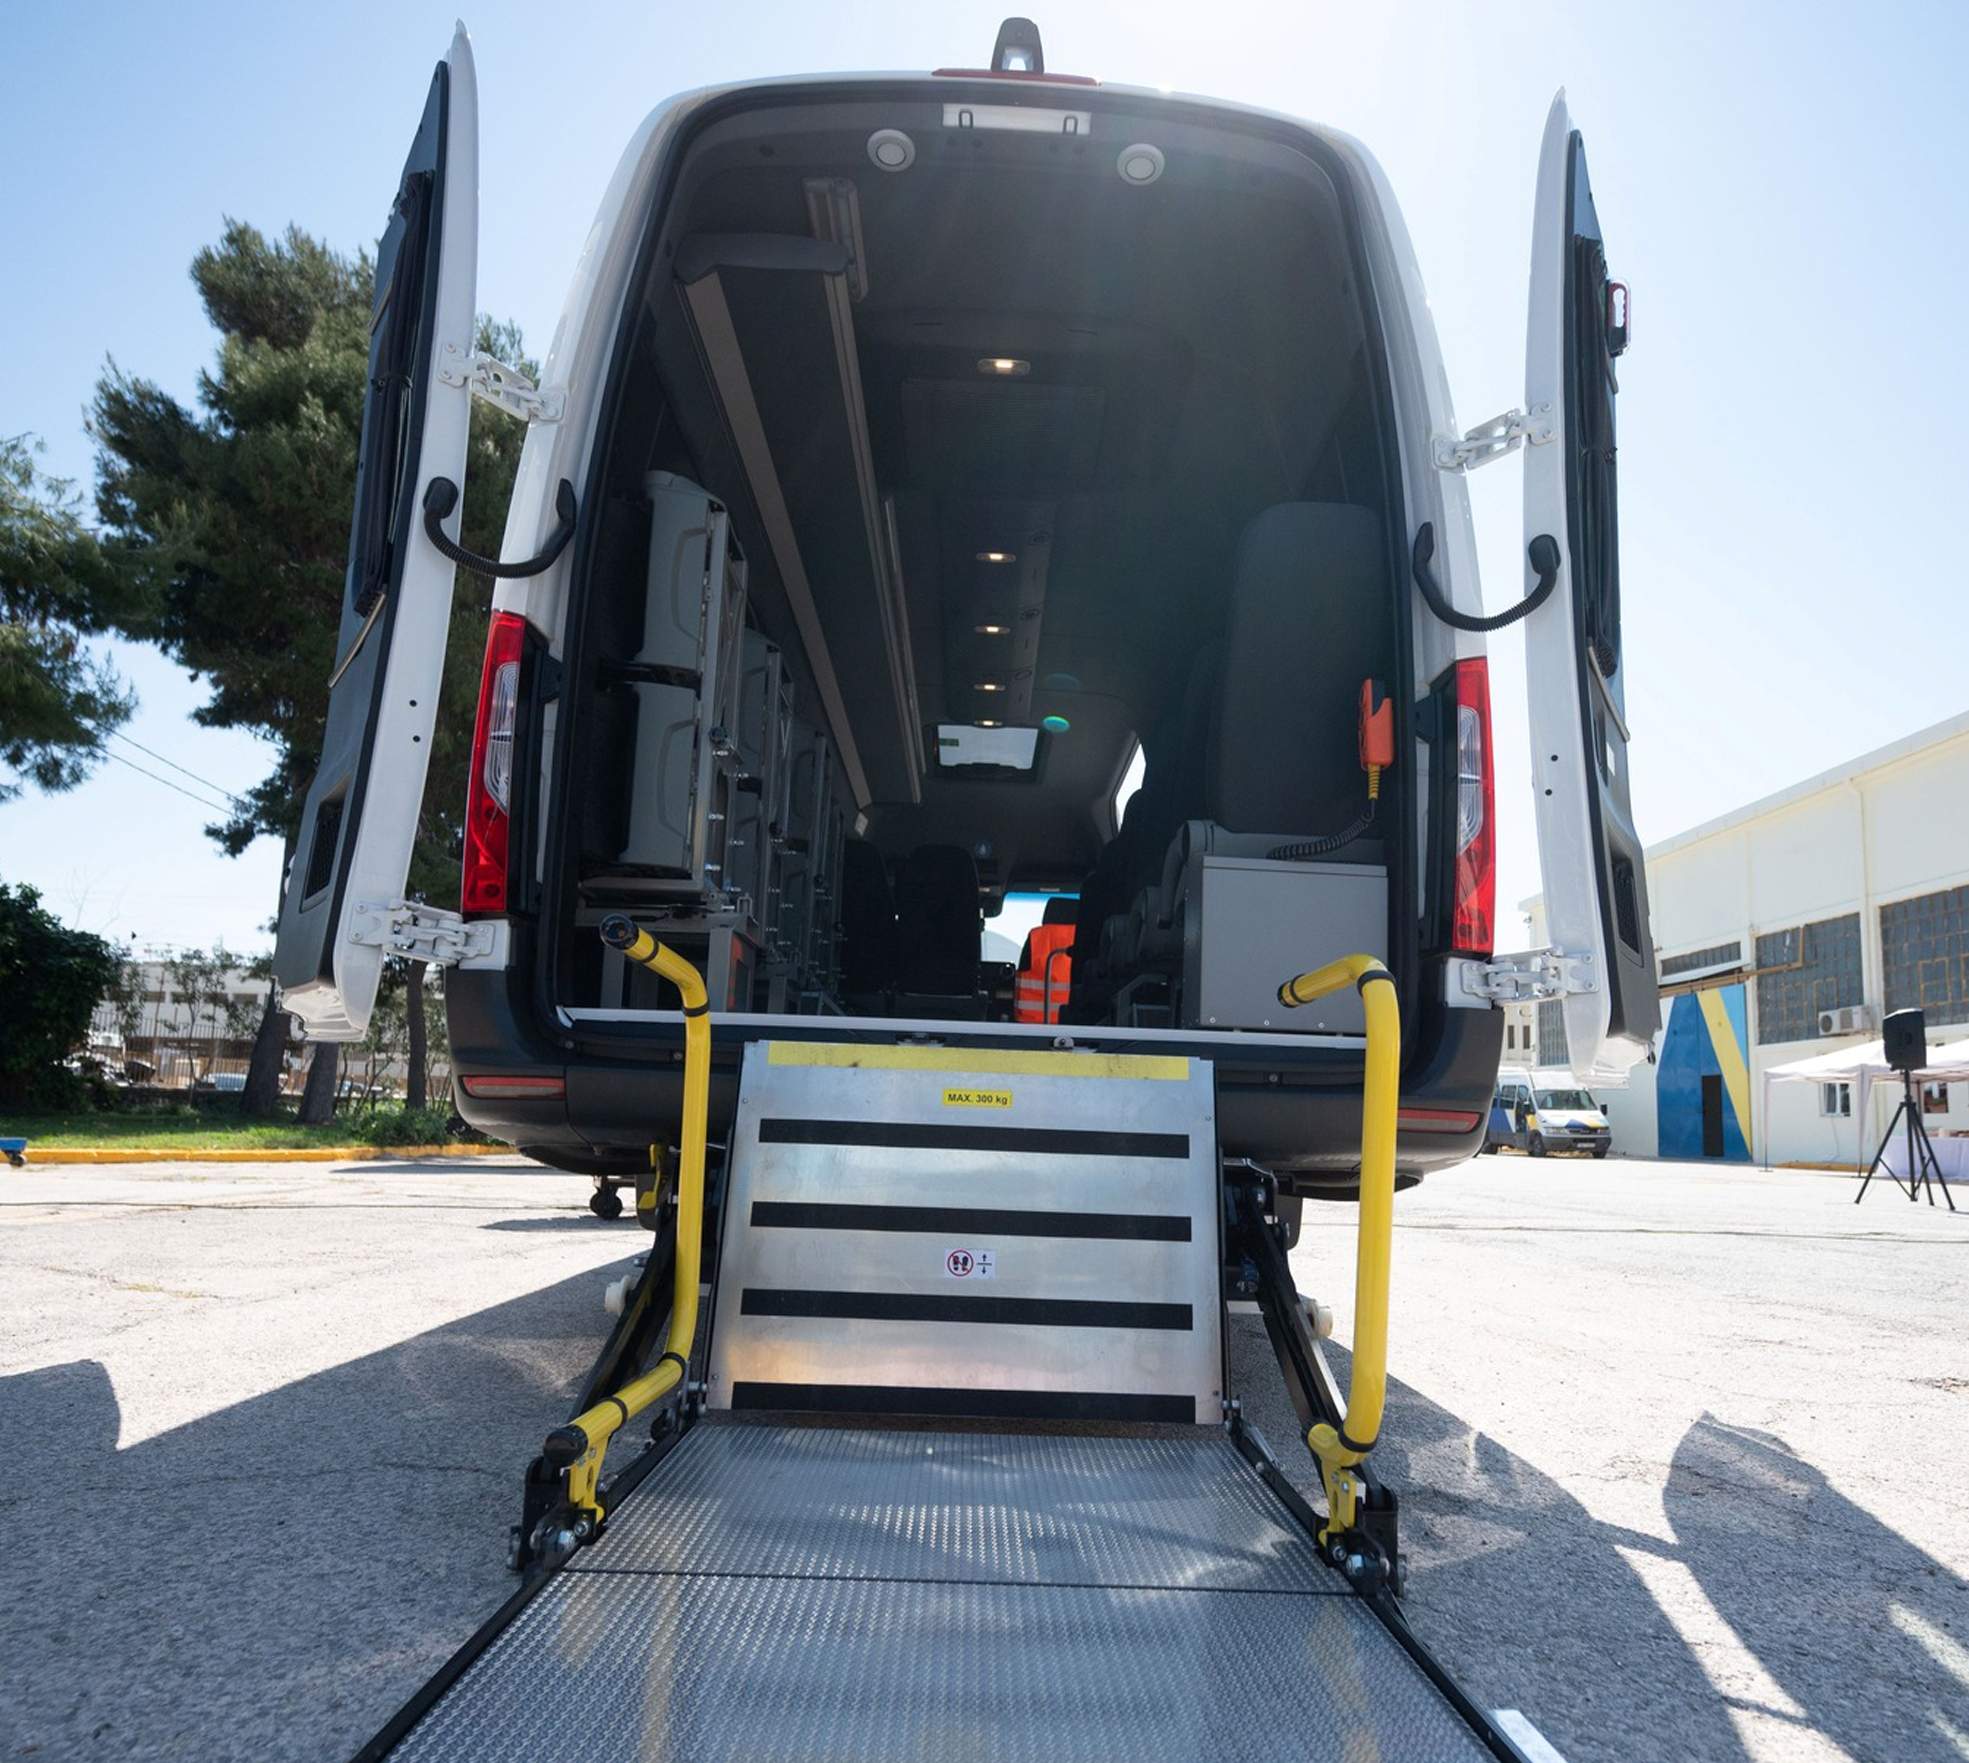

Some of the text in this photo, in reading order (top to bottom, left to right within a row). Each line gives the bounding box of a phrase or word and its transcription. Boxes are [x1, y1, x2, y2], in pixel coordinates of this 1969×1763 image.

[947, 1093, 1008, 1106] MAX. 300 kg
